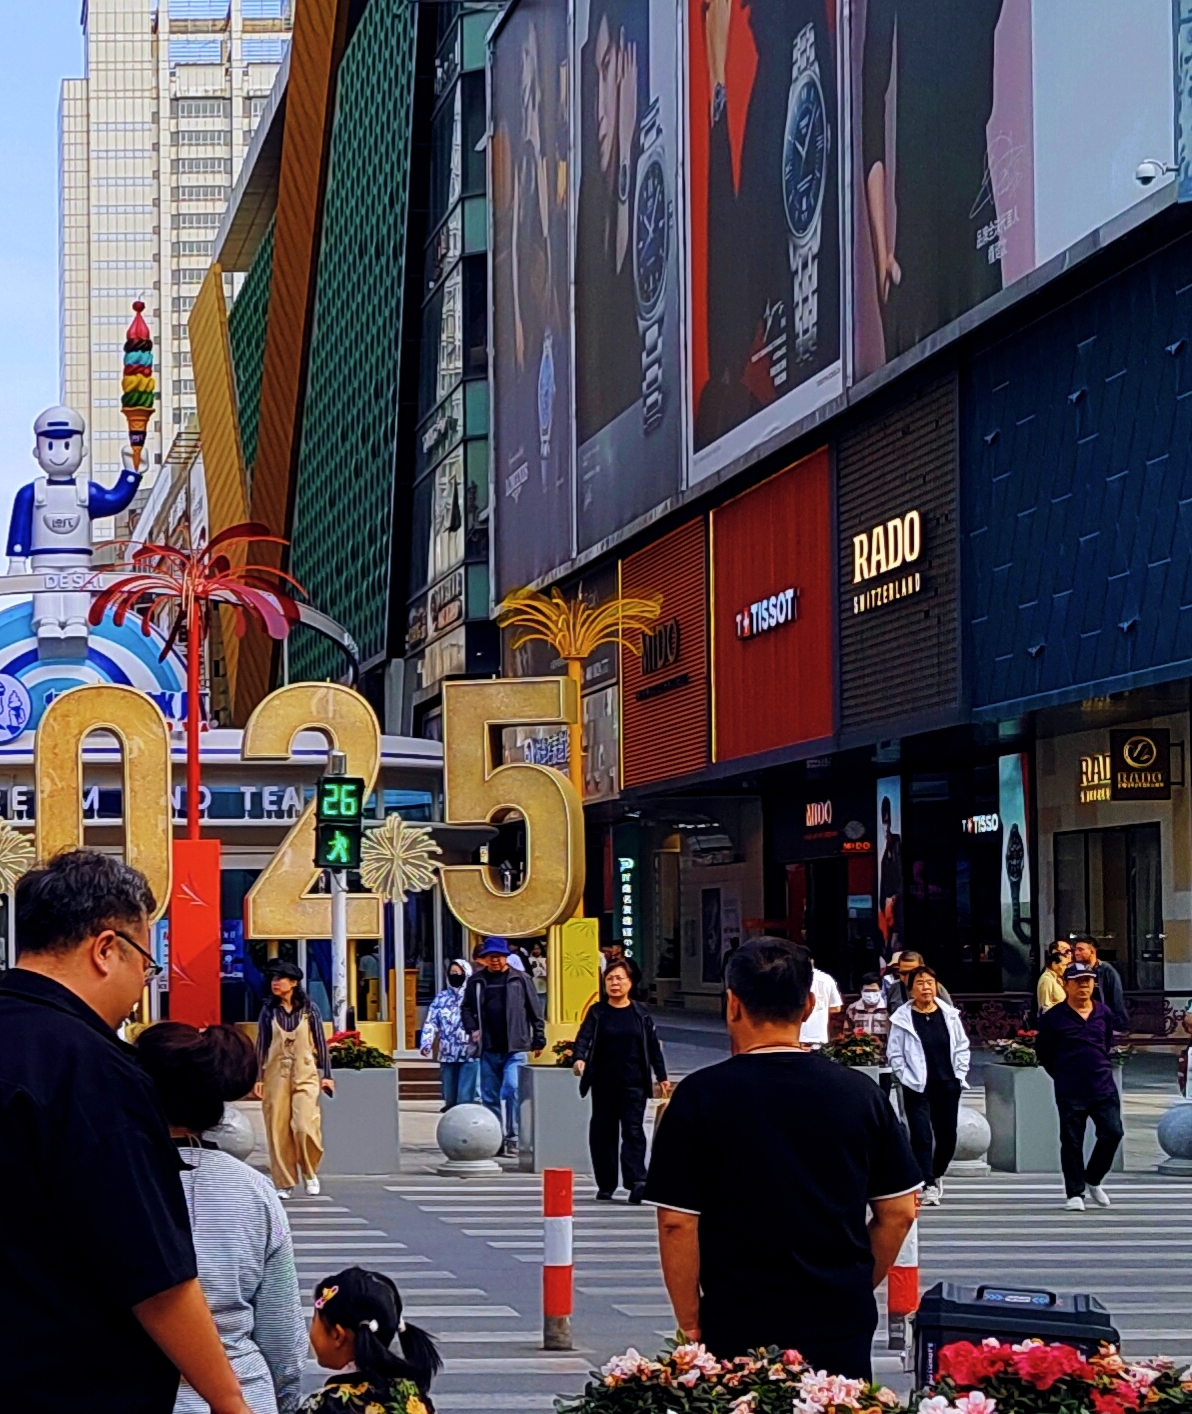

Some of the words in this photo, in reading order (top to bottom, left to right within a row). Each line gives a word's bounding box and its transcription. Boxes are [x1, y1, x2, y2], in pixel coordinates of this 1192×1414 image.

[852, 509, 921, 585] RADO
[750, 587, 795, 635] TISSOT
[853, 572, 921, 615] SWITZERLAND
[239, 785, 304, 811] TEA
[322, 783, 358, 817] 26
